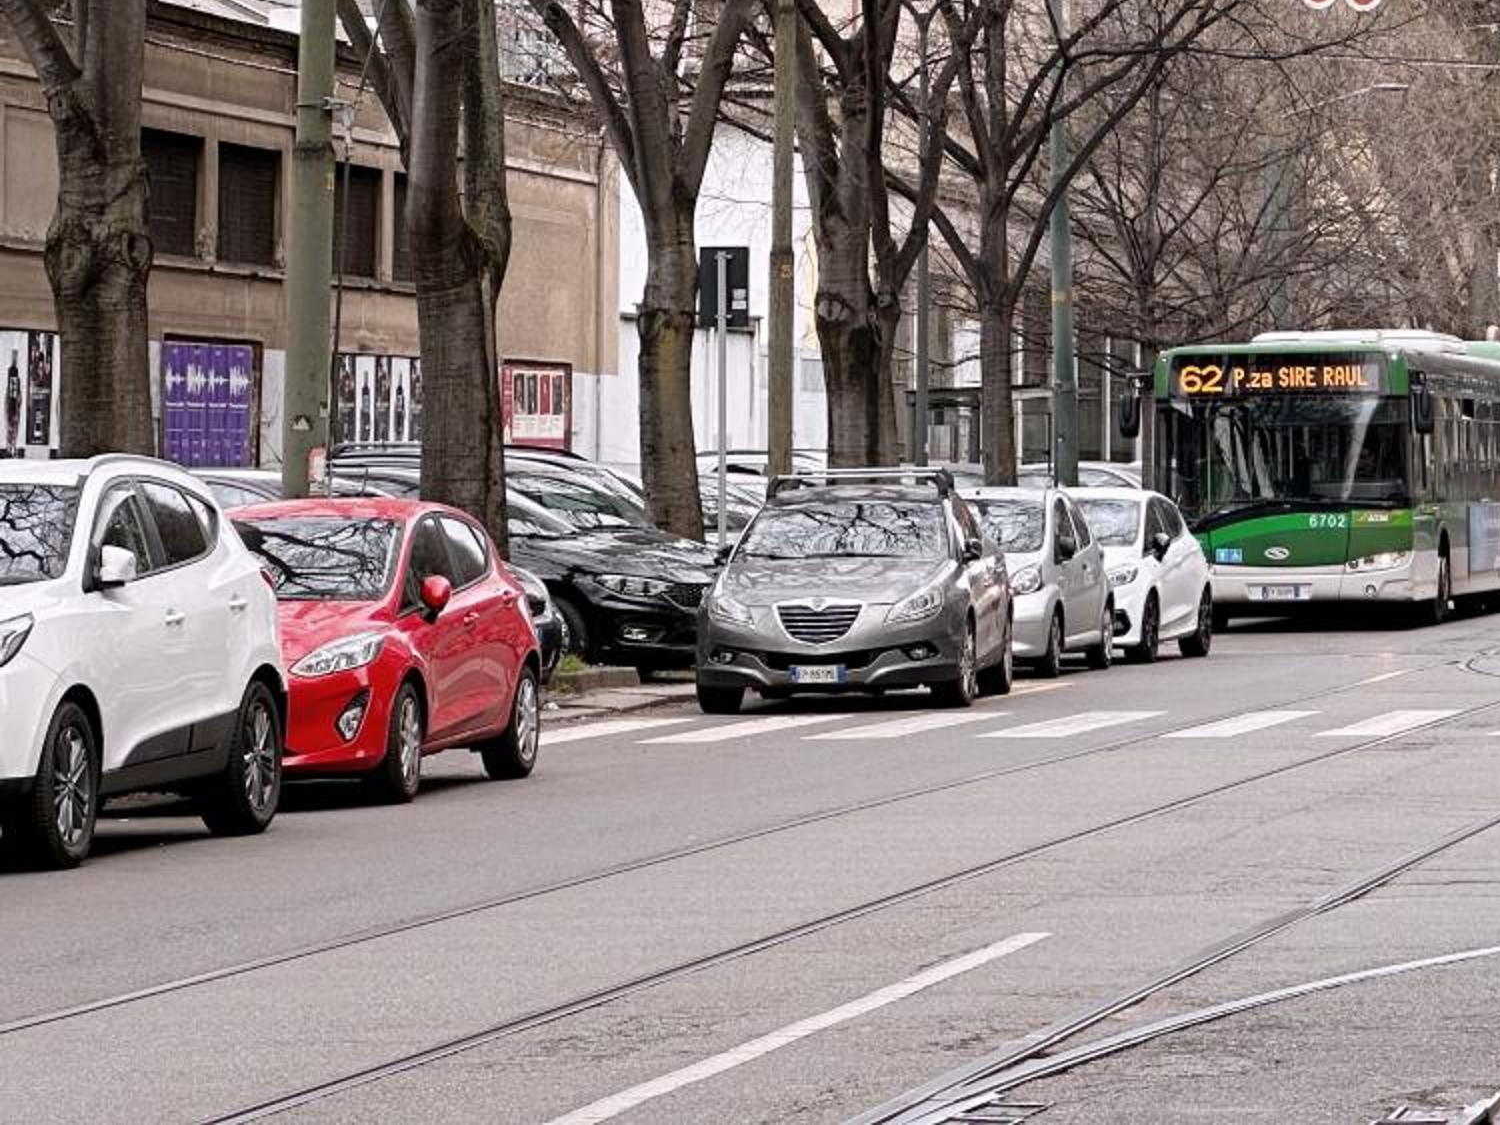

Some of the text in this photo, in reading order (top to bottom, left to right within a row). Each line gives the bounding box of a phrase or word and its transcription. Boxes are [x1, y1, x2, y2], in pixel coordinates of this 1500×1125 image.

[1180, 365, 1368, 392] 62 P.za SIRE RAUL
[1309, 514, 1346, 529] 6702
